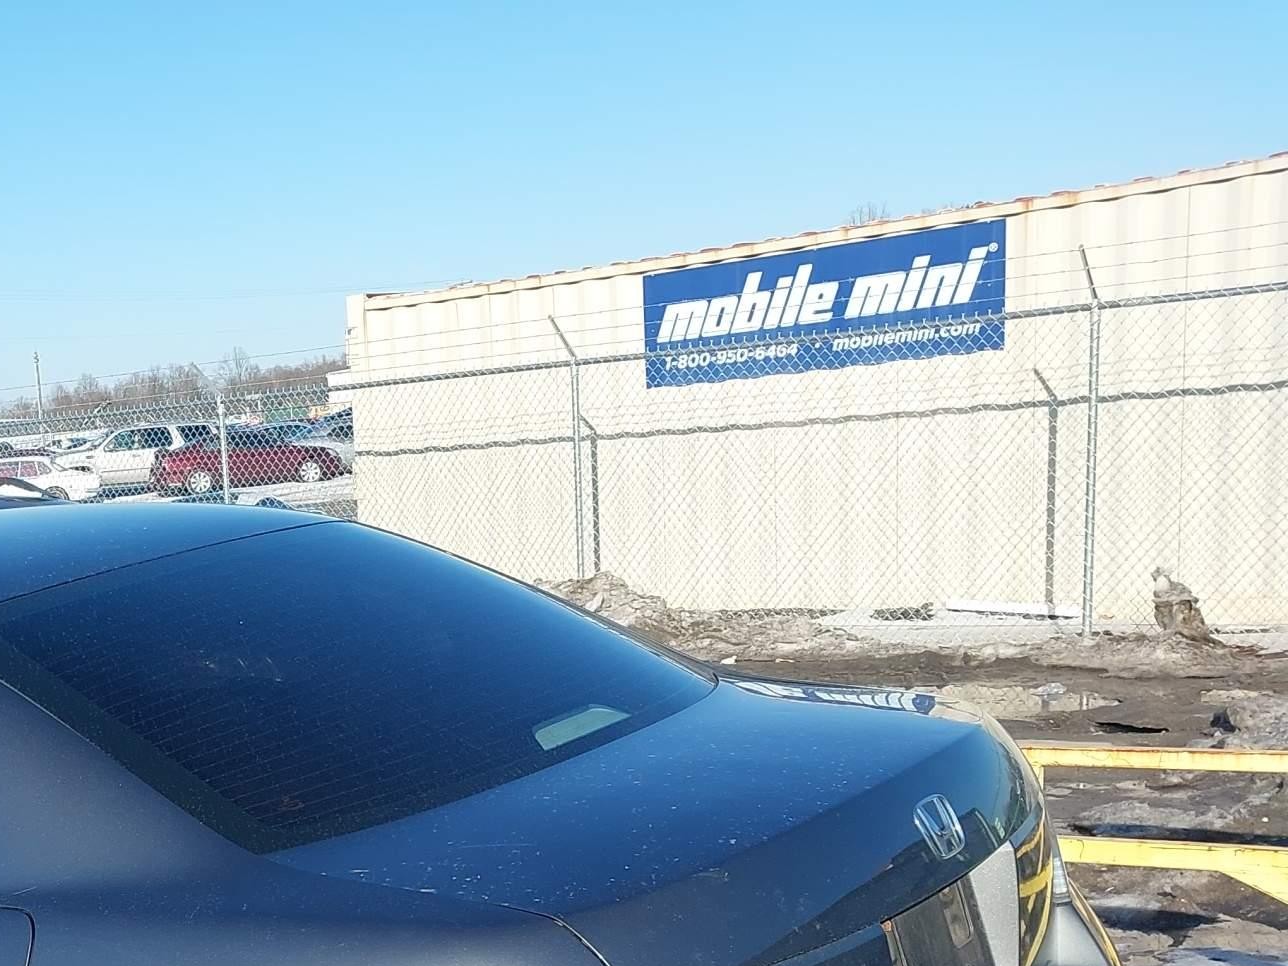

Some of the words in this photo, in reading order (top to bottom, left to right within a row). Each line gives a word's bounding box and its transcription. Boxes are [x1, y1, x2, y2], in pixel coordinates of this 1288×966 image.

[657, 263, 839, 343] mobile
[664, 343, 799, 371] 1-800-950-6464
[831, 323, 981, 351] mobilemini.com
